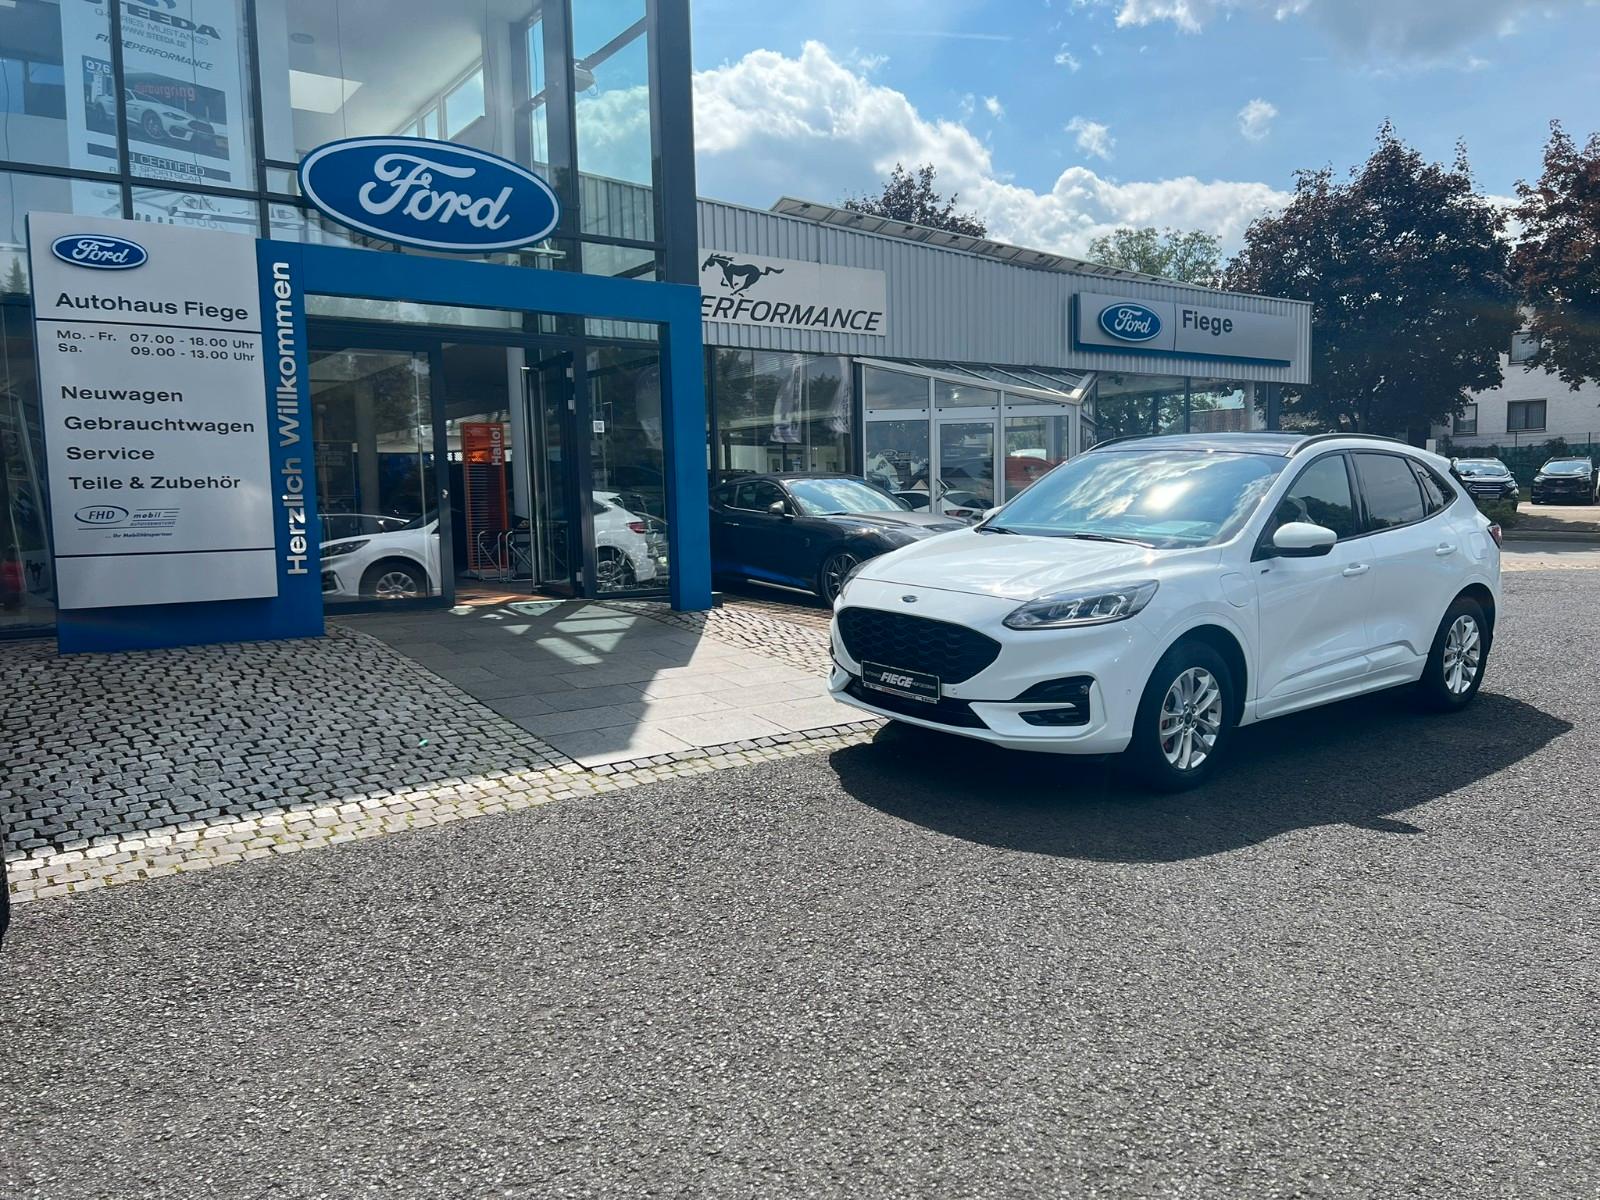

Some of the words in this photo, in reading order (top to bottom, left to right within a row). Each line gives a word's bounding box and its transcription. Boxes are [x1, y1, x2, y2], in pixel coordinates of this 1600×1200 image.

[147, 20, 209, 46] MUSTANGS
[95, 33, 214, 71] FIEPERFORMANCE
[140, 155, 205, 176] CERTIFIED
[358, 152, 514, 230] Ford
[72, 239, 129, 264] Ford
[55, 291, 178, 315] Autohaus
[184, 301, 249, 322] Fiege
[701, 294, 883, 332] ERFORMANCE
[1114, 308, 1151, 334] Ford
[1182, 309, 1234, 337] Fiege
[56, 329, 86, 341] Mo.
[98, 331, 117, 342] Fr.
[130, 332, 175, 345] 07.00
[189, 336, 228, 348] 18.00
[233, 340, 254, 350] Uhr
[58, 342, 83, 354] Sa.
[130, 345, 176, 358] 09.00
[190, 348, 229, 361] 13.00
[233, 352, 255, 362] Uhr
[271, 261, 300, 447] Willkommen
[61, 385, 183, 404] Neuwagen
[64, 416, 255, 435] Gebrauchtwagen
[66, 446, 155, 461] Service
[489, 427, 502, 466] Hallo!
[69, 476, 123, 491] Teile
[130, 477, 145, 490] &
[151, 475, 241, 490] Zubehör
[88, 510, 115, 520] FHD
[281, 457, 309, 575] Herzlich
[879, 671, 914, 688] FIEGE
